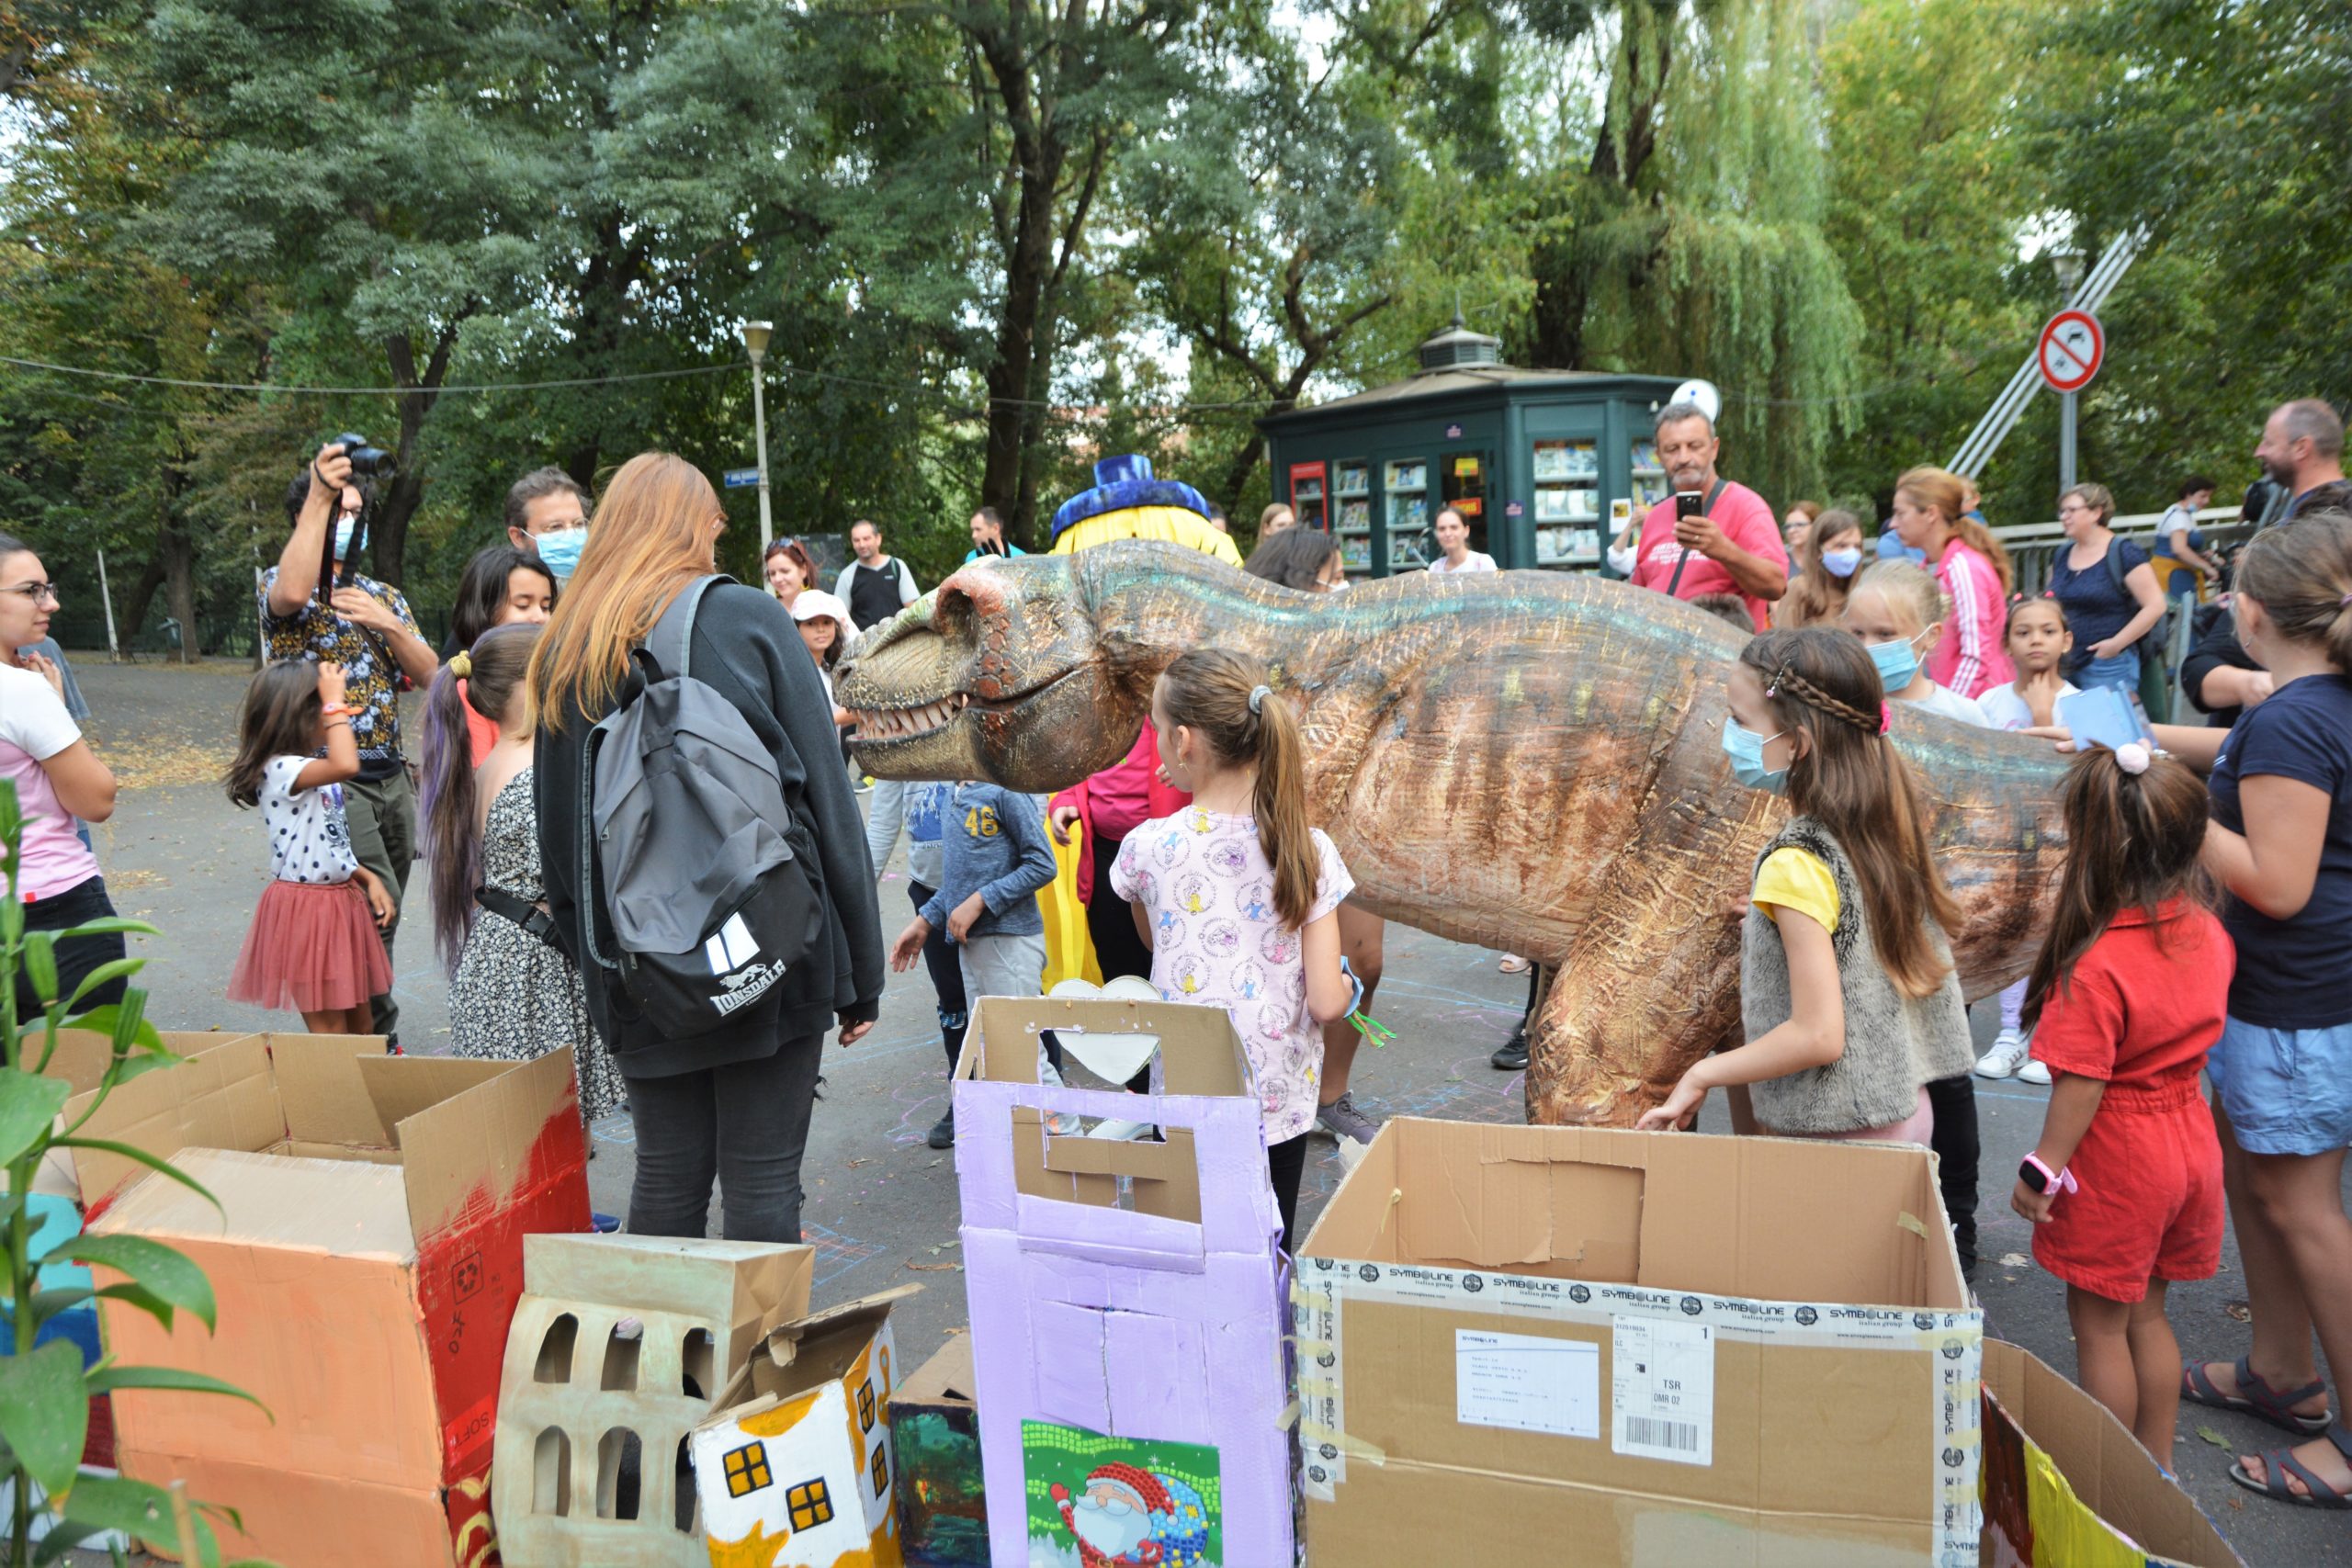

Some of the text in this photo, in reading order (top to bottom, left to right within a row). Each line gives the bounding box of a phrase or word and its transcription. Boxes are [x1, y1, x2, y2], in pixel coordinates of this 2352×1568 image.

[965, 806, 999, 837] 46
[709, 958, 786, 1017] LONSDALE
[1390, 1269, 1453, 1281] SYMBOLINE
[1493, 1278, 1560, 1292] SYMBOLINE
[1541, 1292, 1560, 1301] group
[1601, 1289, 1670, 1304] SYMBOLINE
[1629, 1301, 1650, 1309] italian
[1651, 1303, 1670, 1312] group
[1713, 1301, 1784, 1315] SYMBOLINE
[1742, 1313, 1764, 1321] italian
[1765, 1314, 1784, 1324] group
[1830, 1309, 1903, 1320] SYMBOLINE
[1702, 1326, 1708, 1340] 1
[1663, 1379, 1681, 1391] TSR
